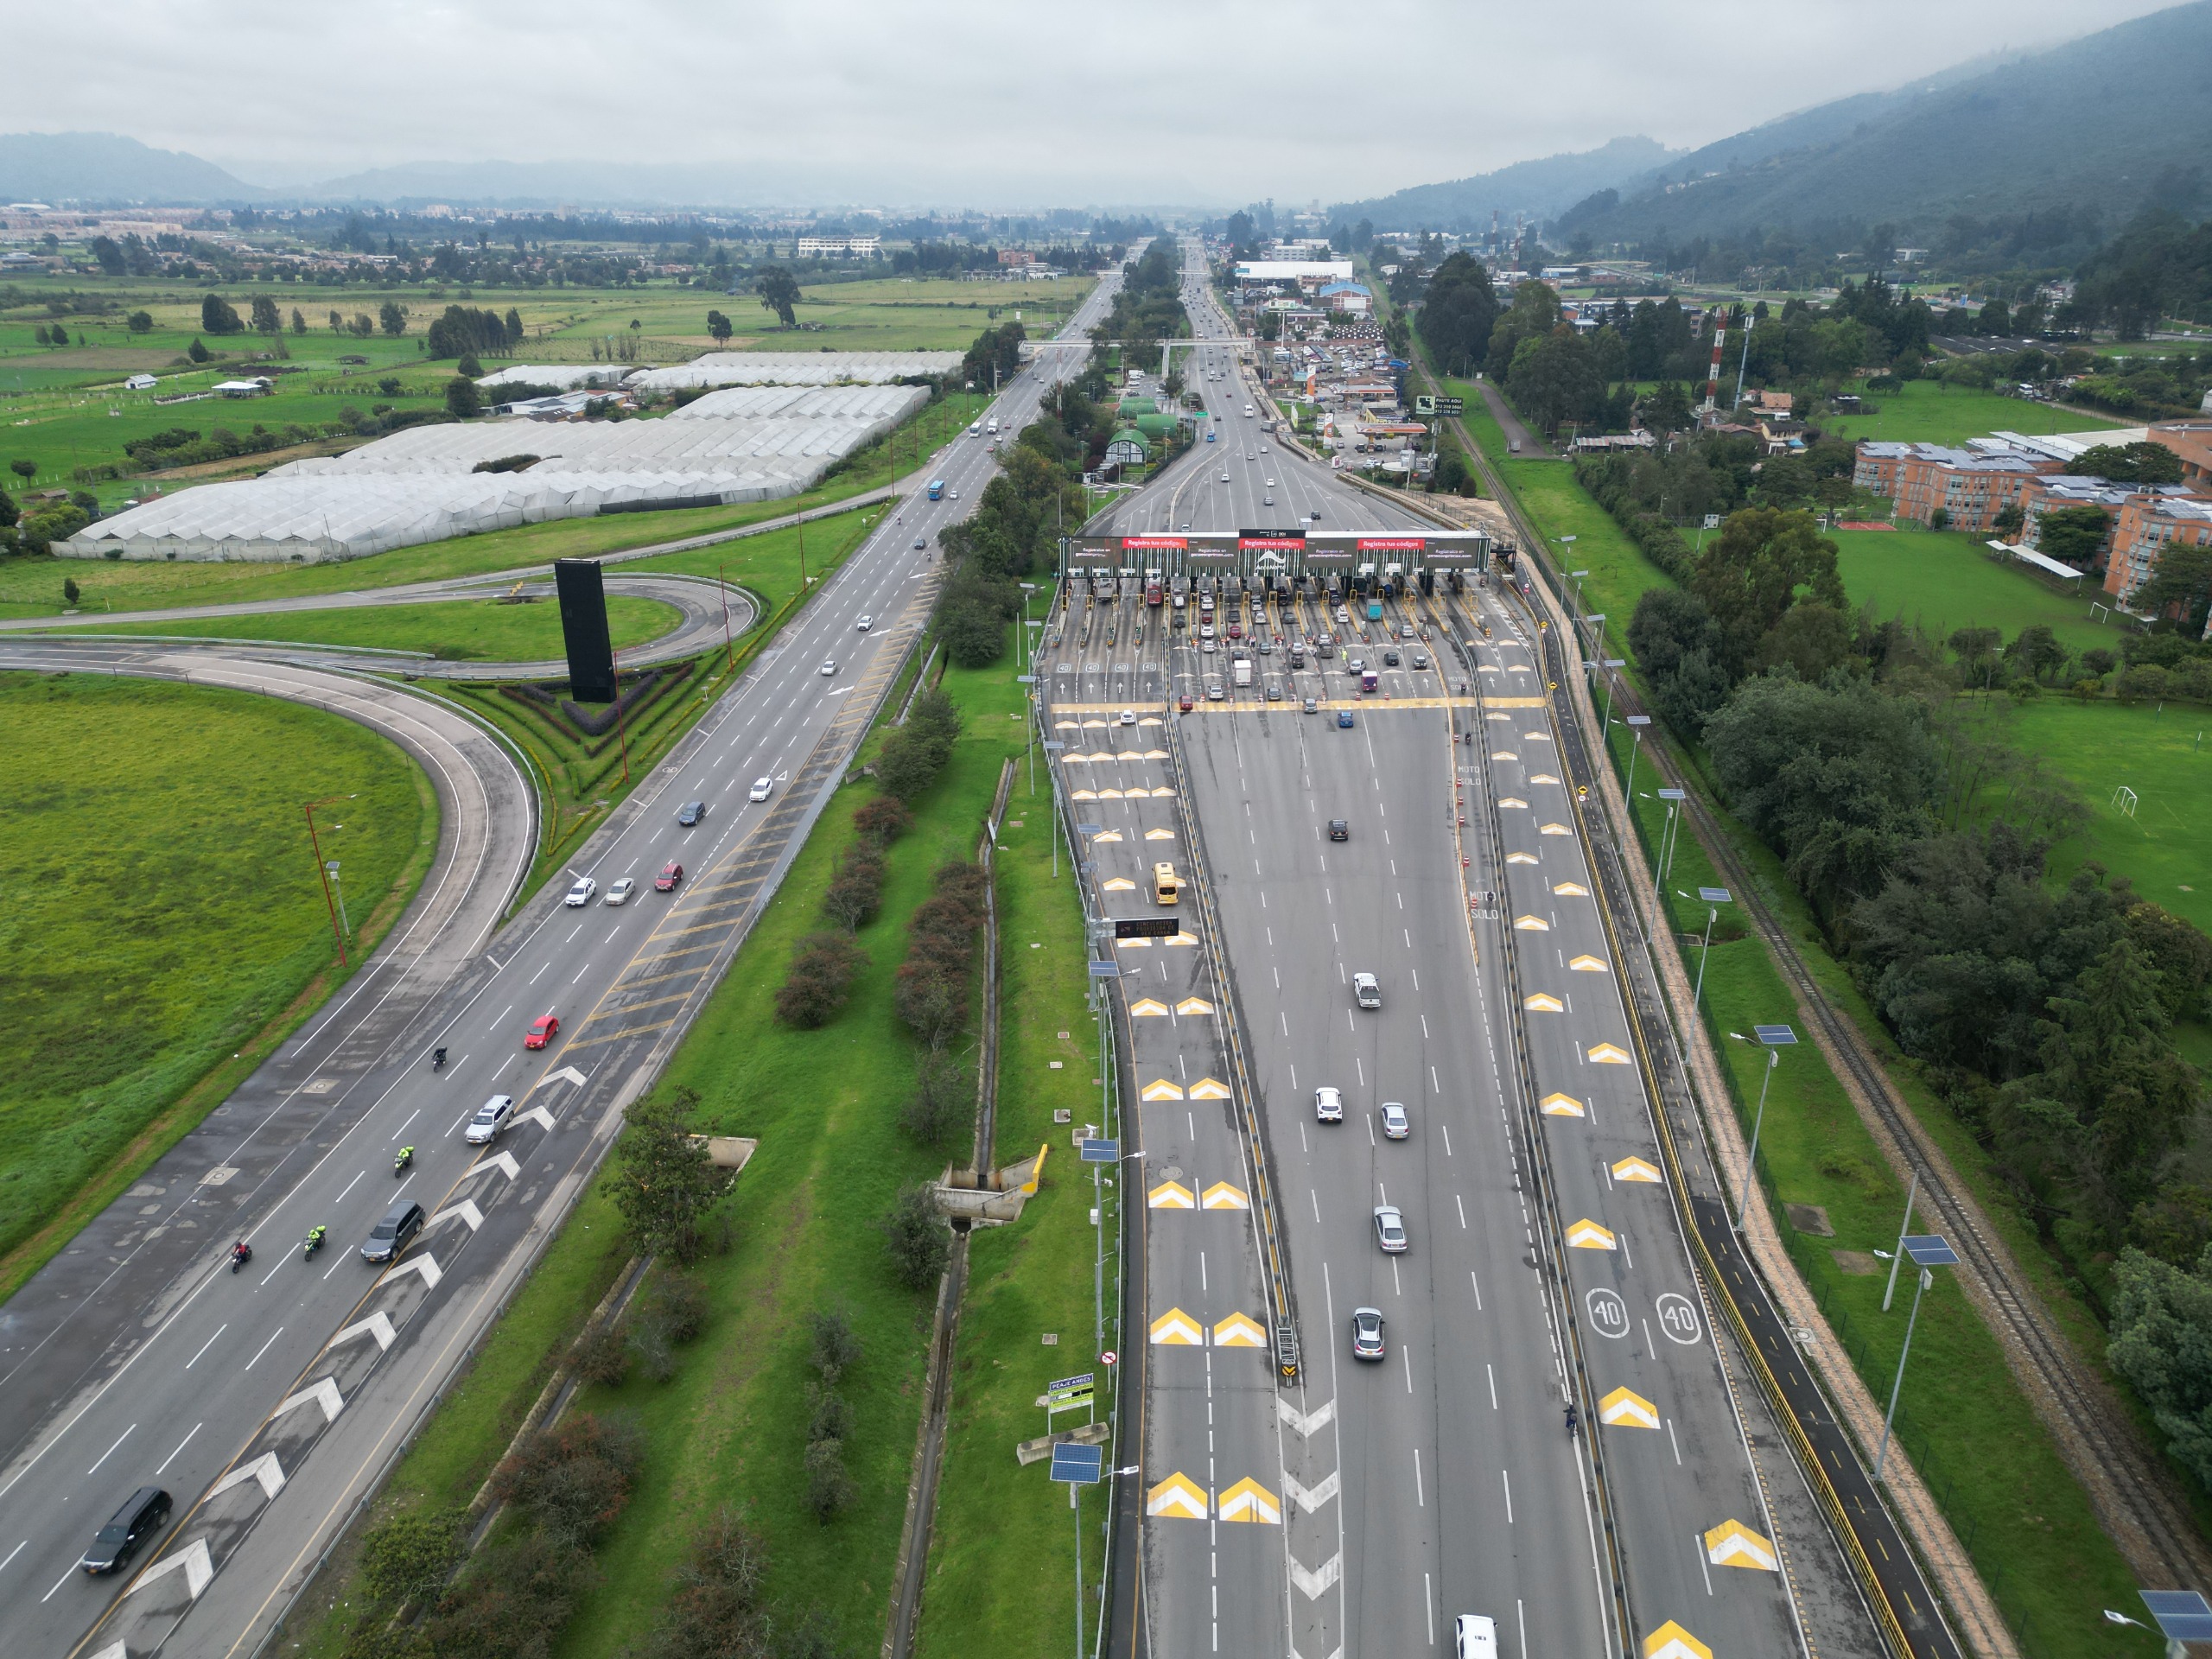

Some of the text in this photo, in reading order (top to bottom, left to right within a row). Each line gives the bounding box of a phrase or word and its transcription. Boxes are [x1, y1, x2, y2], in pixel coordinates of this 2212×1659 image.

[1471, 909, 1498, 919] SOLO
[1593, 1300, 1620, 1325] 40
[1664, 1306, 1694, 1331] 40
